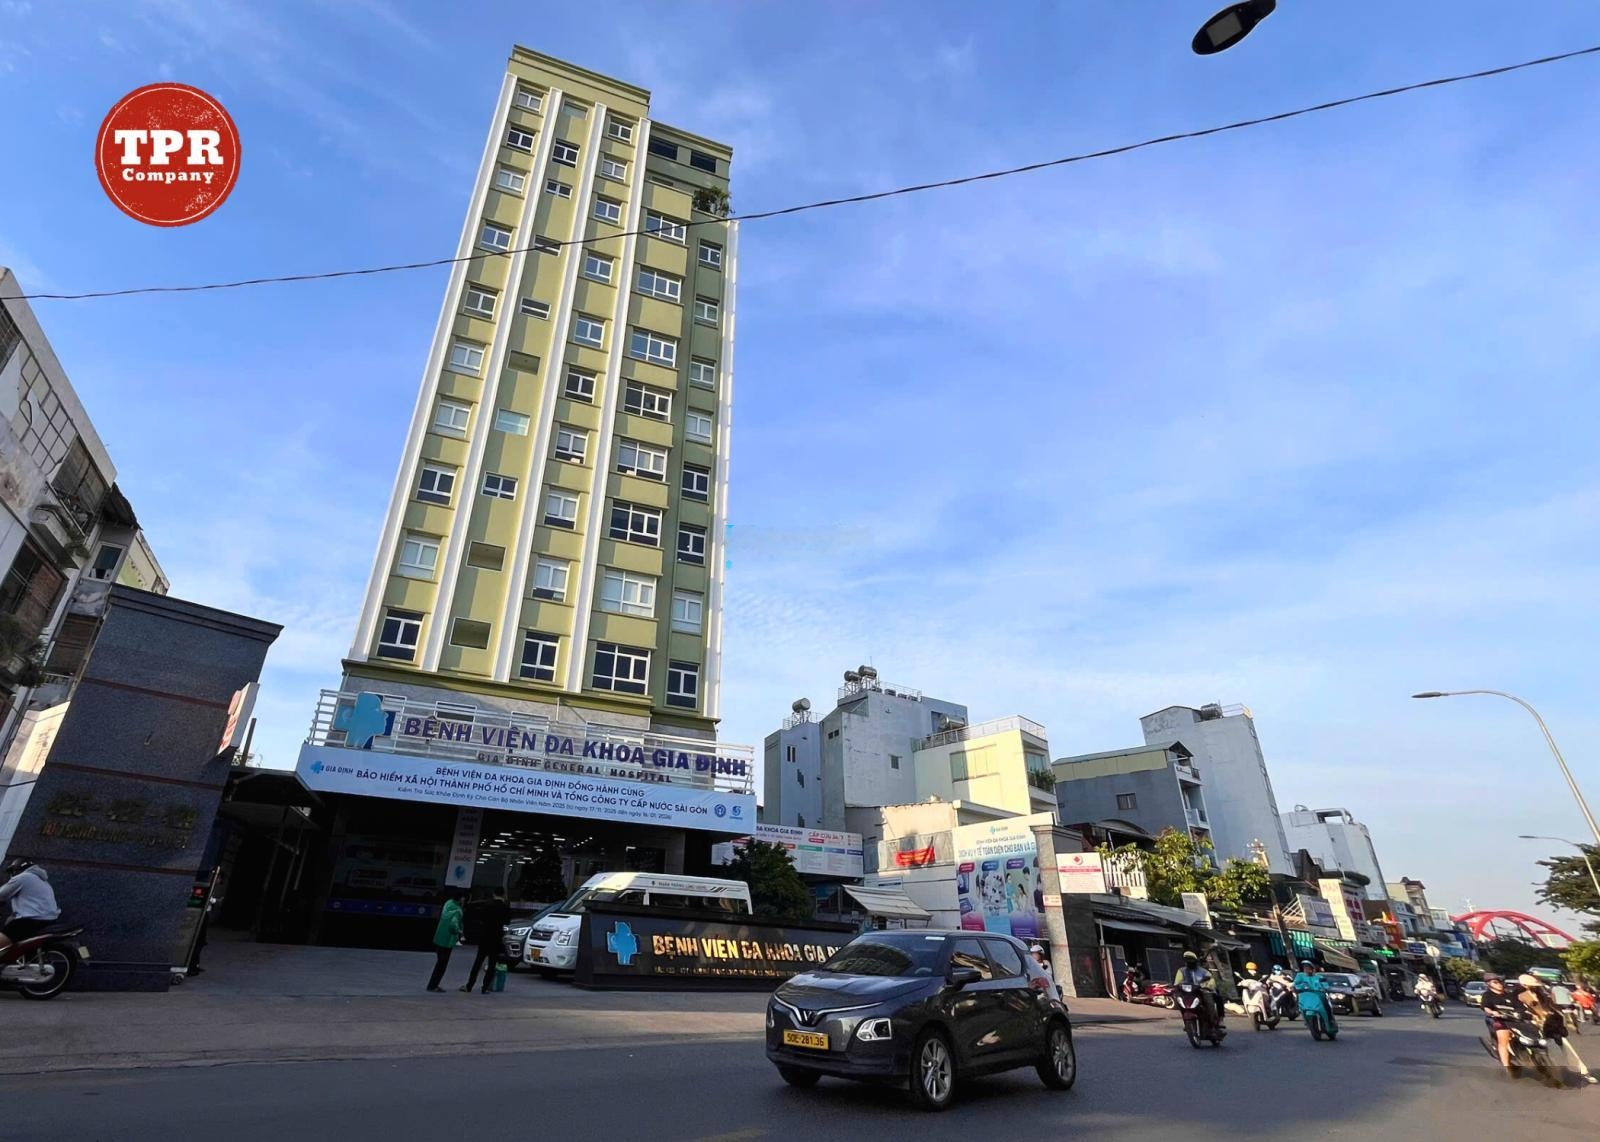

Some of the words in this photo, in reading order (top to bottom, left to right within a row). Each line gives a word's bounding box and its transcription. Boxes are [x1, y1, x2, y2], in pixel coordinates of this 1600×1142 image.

[404, 715, 473, 744] BỆNH
[481, 727, 537, 753] VIỆN
[544, 734, 575, 755] ĐA
[583, 740, 645, 764] KHOA
[652, 750, 690, 770] GIA
[695, 755, 746, 779] ĐỊNH
[436, 767, 459, 778] BỆNH
[462, 769, 482, 781] VIỆN
[484, 772, 498, 781] ĐA
[500, 774, 524, 784] KHOA
[527, 777, 542, 786] GIA
[545, 779, 566, 790] ĐỊNH
[568, 779, 594, 792] ĐỒNG
[596, 783, 619, 795] HÀNH
[621, 786, 645, 797] CÙNG
[544, 761, 600, 775] GENERAL
[610, 768, 672, 783] HOSPITAL
[356, 768, 378, 780] BẢO
[420, 775, 437, 788] HỘI
[440, 778, 470, 790] THÀNH
[472, 780, 492, 792] PHỐ
[494, 782, 507, 794] HỒ
[510, 785, 525, 796] CHÍ
[526, 788, 549, 799] MINH
[551, 788, 562, 800] VÀ
[592, 793, 617, 805] CÔNG
[619, 798, 629, 807] TY
[631, 797, 648, 808] CẤP
[803, 944, 827, 963] GIA
